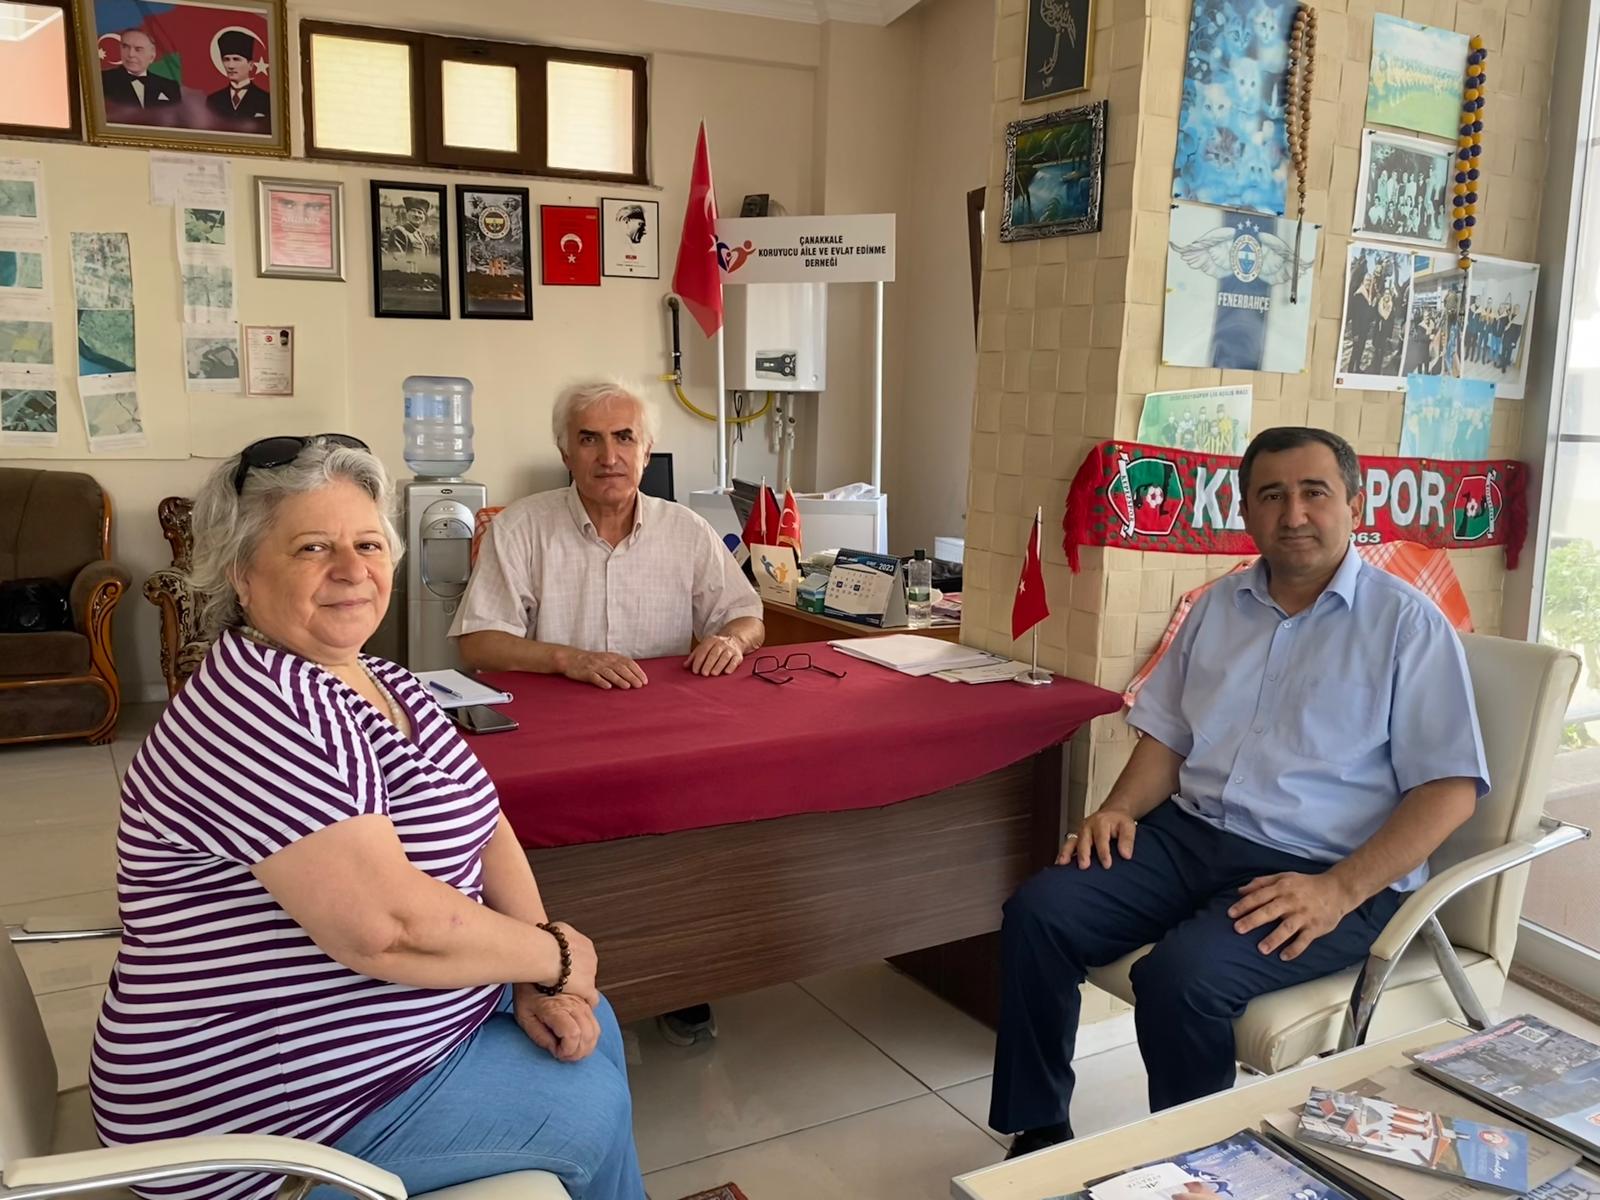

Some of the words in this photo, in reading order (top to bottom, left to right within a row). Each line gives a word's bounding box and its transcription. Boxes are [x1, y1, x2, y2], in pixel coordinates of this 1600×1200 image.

[799, 235, 843, 246] ÇANAKKALE
[758, 248, 798, 257] KORUYUCU
[800, 246, 816, 256] AİLE
[818, 246, 828, 255] VE
[831, 246, 854, 256] EVLAT
[856, 244, 886, 255] EDİNME
[805, 257, 837, 267] DERNEĞİ
[1217, 292, 1271, 313] FENERBAHÇE
[1349, 532, 1381, 543] 963
